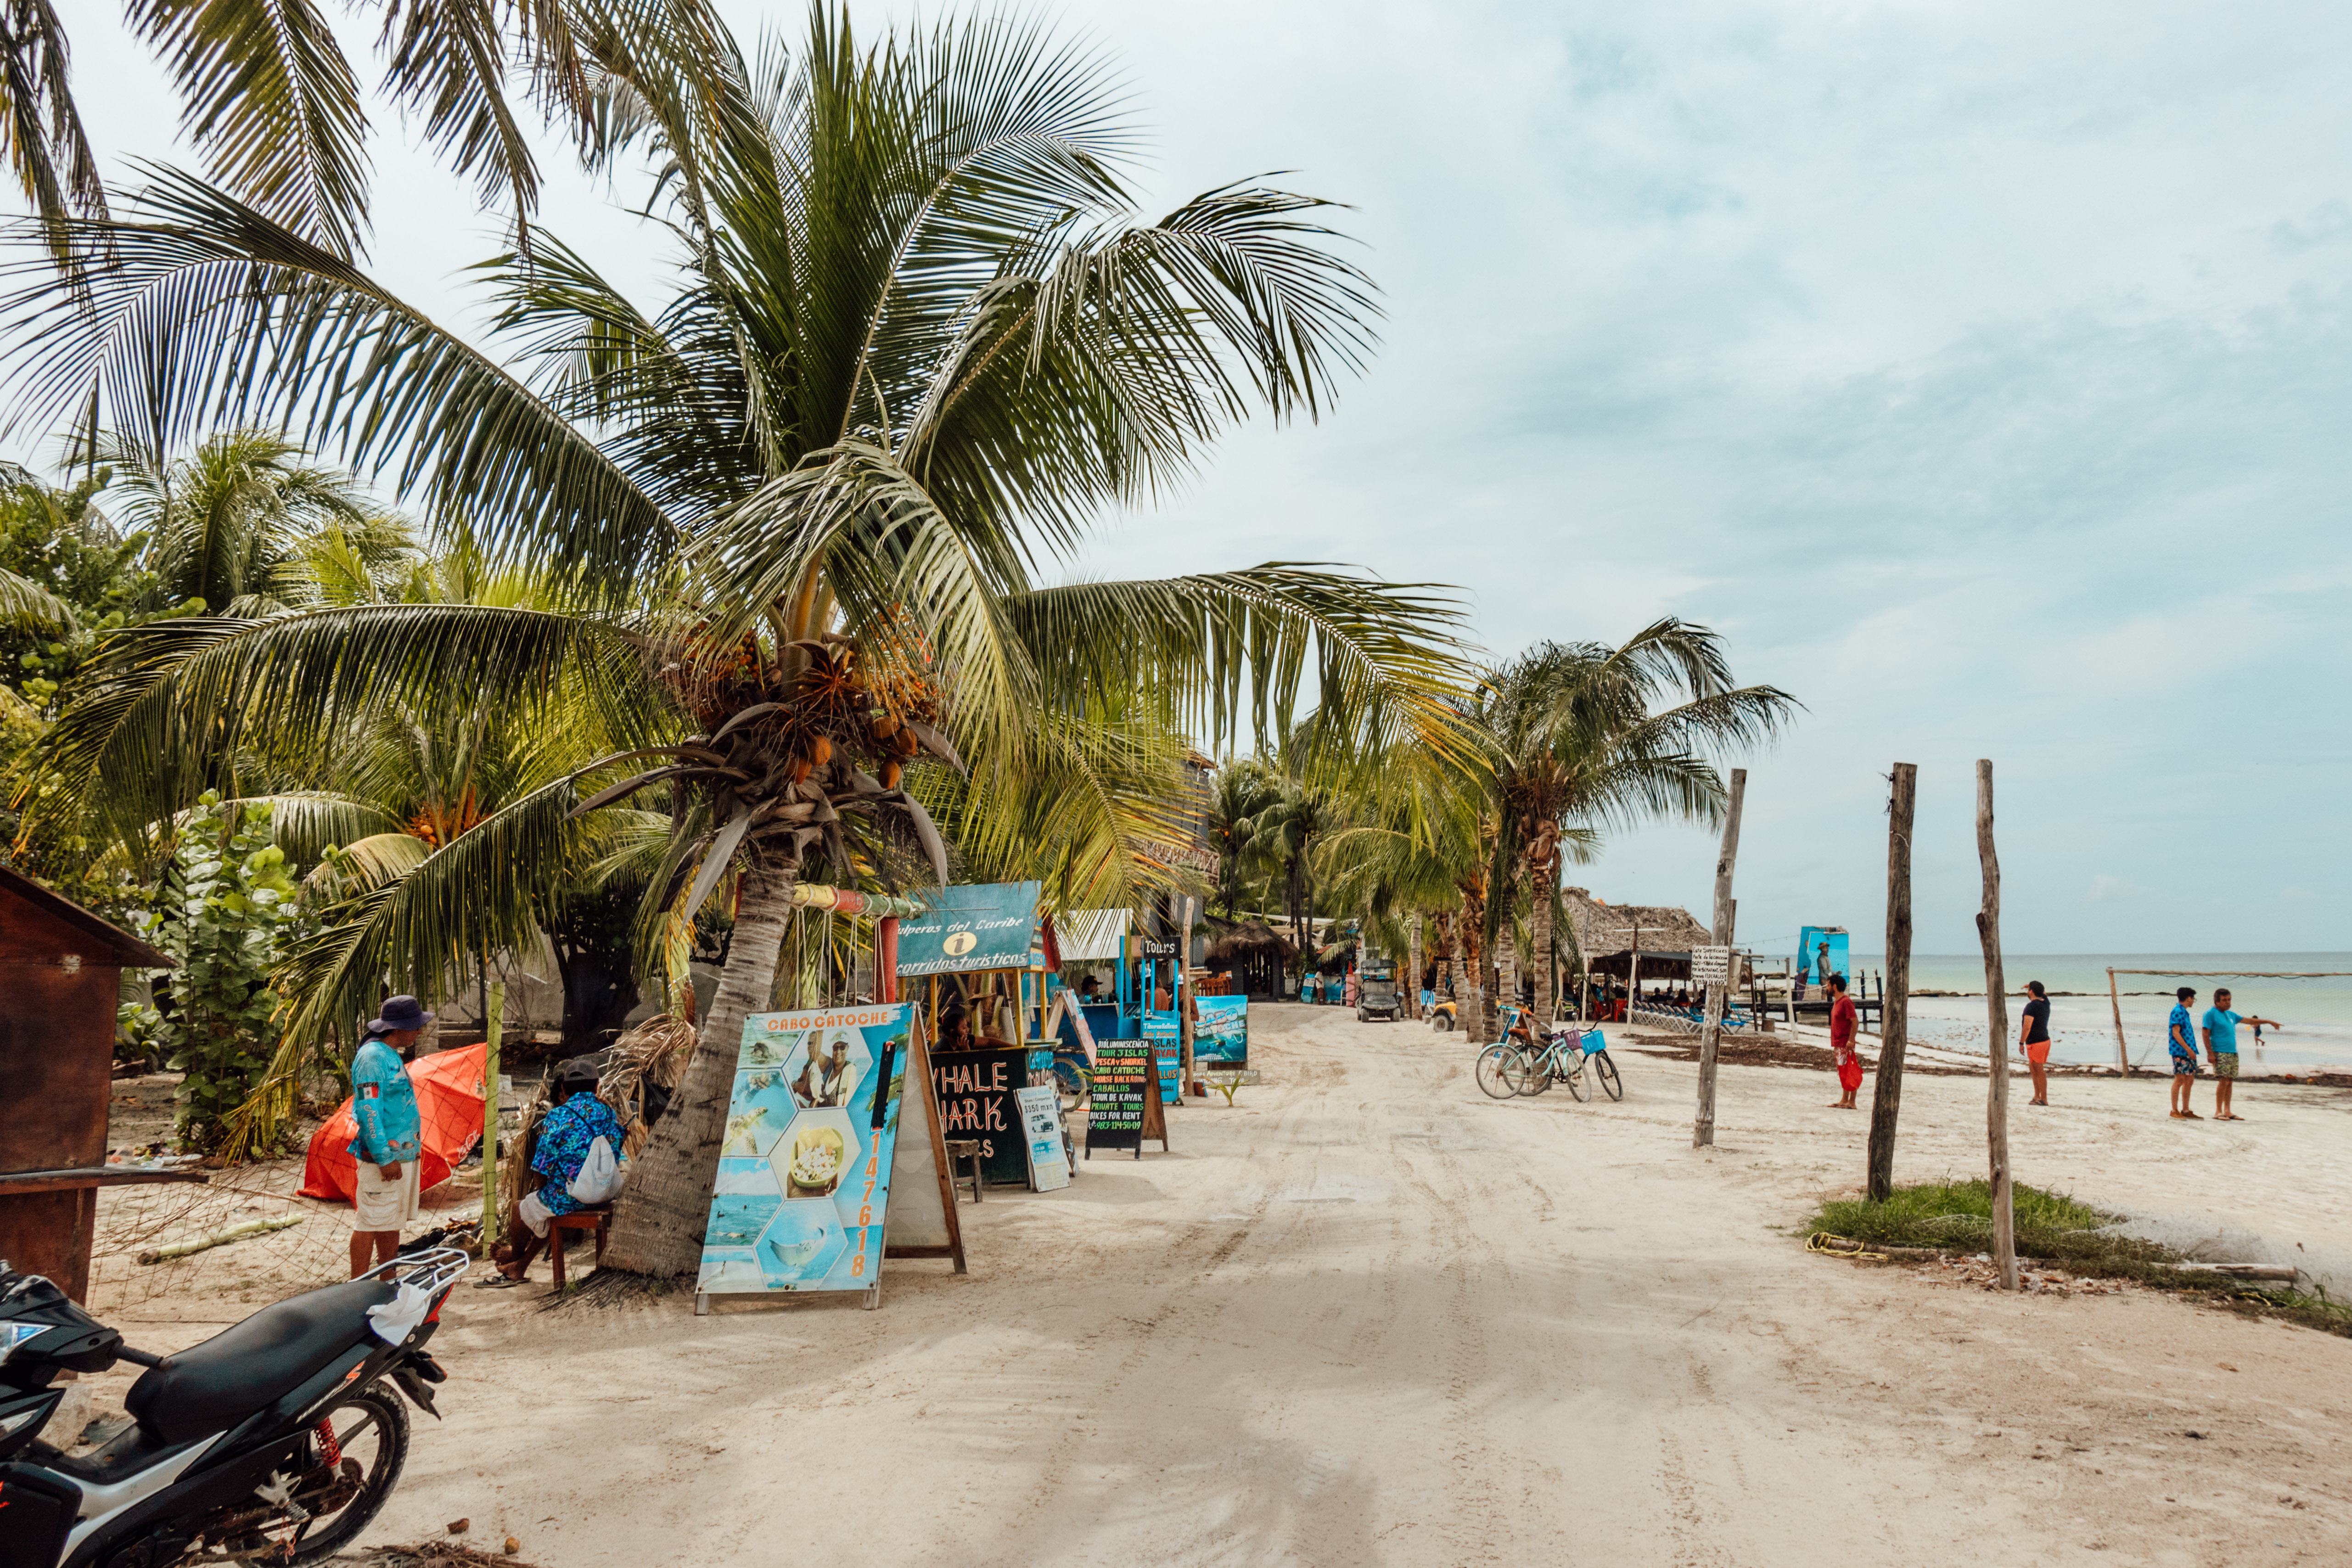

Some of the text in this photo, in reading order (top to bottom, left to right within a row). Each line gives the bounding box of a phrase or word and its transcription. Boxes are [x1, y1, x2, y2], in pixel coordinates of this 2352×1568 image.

[898, 917, 1023, 937] ulperos del Caribe
[1145, 940, 1175, 954] Tours
[896, 958, 956, 974] corridos
[768, 1012, 888, 1031] CABO CATOCHE
[1195, 1008, 1238, 1028] CABO
[1196, 1019, 1246, 1037] CATOCHE
[1154, 1038, 1177, 1048] SLAS
[1097, 1049, 1116, 1057] TOUR
[1124, 1049, 1148, 1057] ISLAS
[1155, 1049, 1178, 1059] AYAK
[1120, 1058, 1148, 1066] SNORKEL
[1095, 1066, 1145, 1074] CABO CATOCHE
[1094, 1075, 1113, 1084] HORSE
[1092, 1093, 1108, 1102] TOUR
[1119, 1093, 1142, 1102] KAYAK
[1025, 1104, 1039, 1113] $350
[1091, 1102, 1144, 1111] PRIVATE TOURS
[941, 1096, 1007, 1134] HARK
[1089, 1111, 1141, 1120] BIKES FOR RENT
[363, 1104, 376, 1139] Mexico
